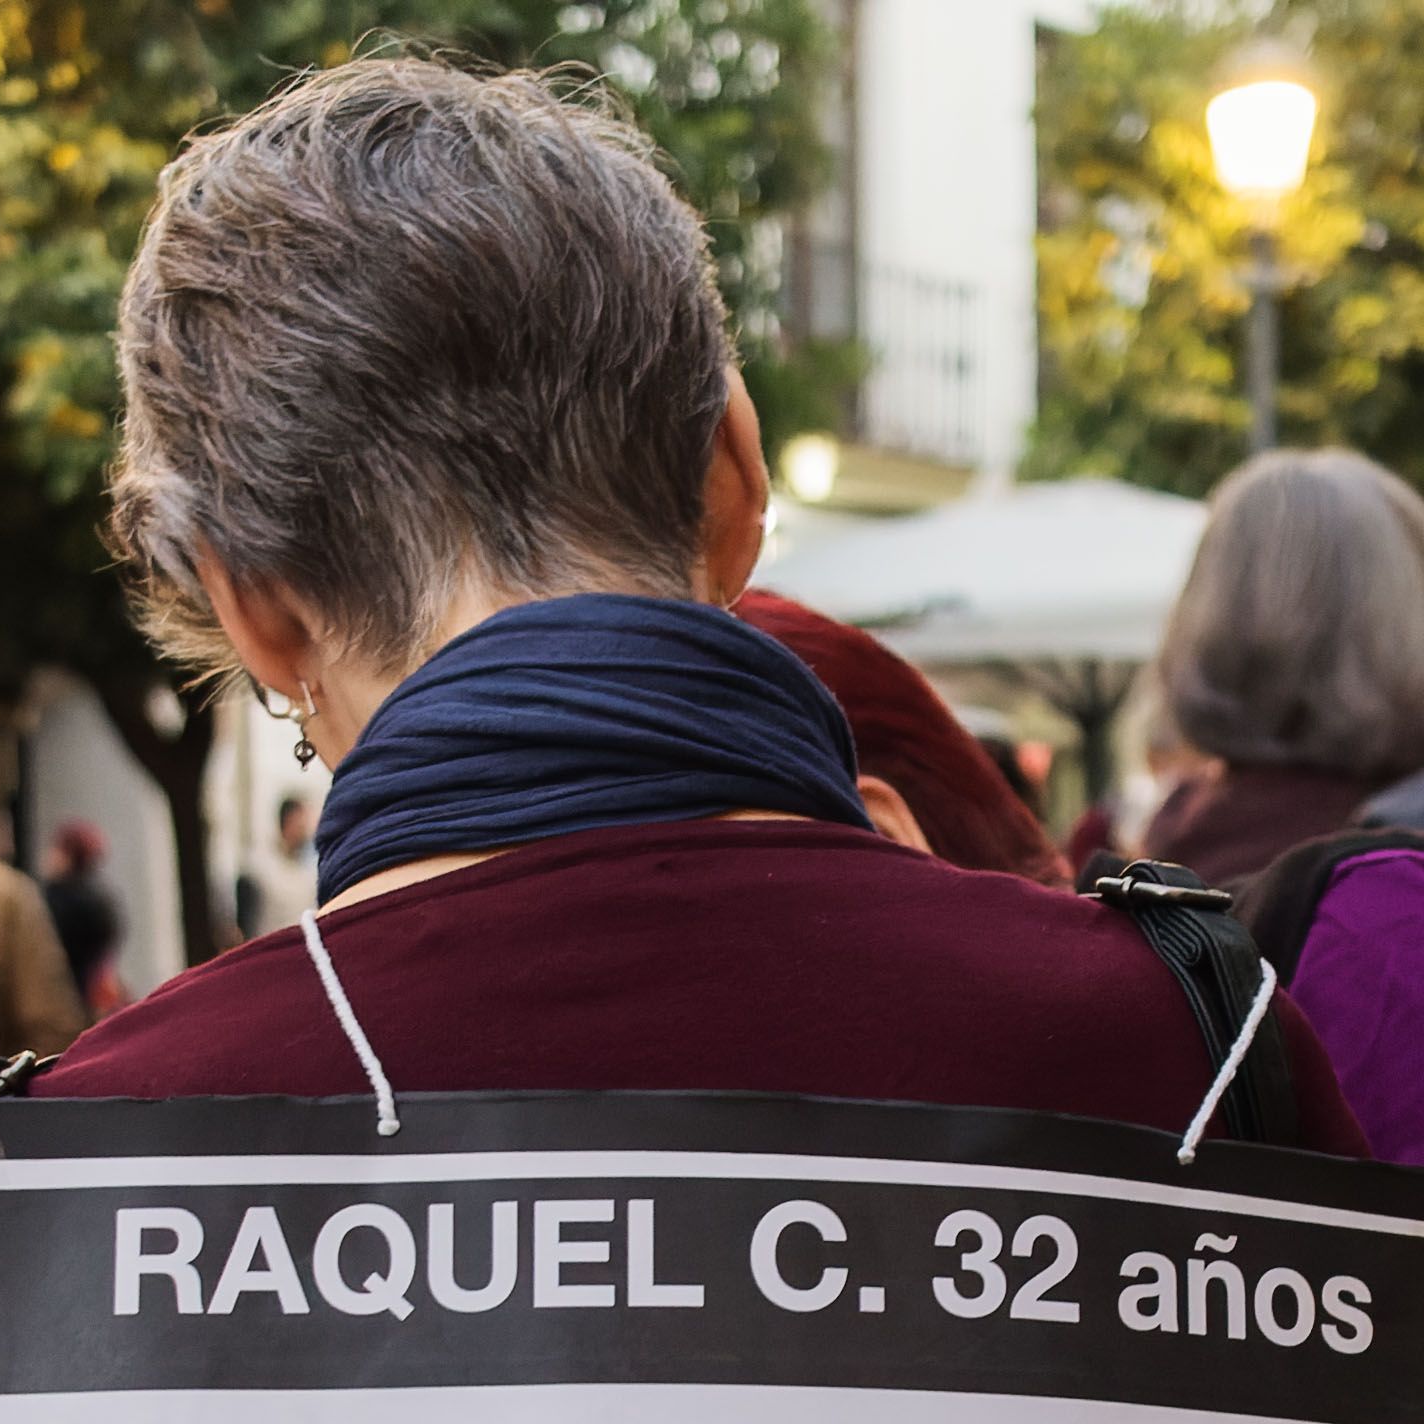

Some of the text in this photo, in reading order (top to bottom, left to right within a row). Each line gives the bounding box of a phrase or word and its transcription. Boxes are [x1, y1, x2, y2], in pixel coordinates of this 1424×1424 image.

[112, 1197, 1375, 1356] RAQUEL C. 32 años
